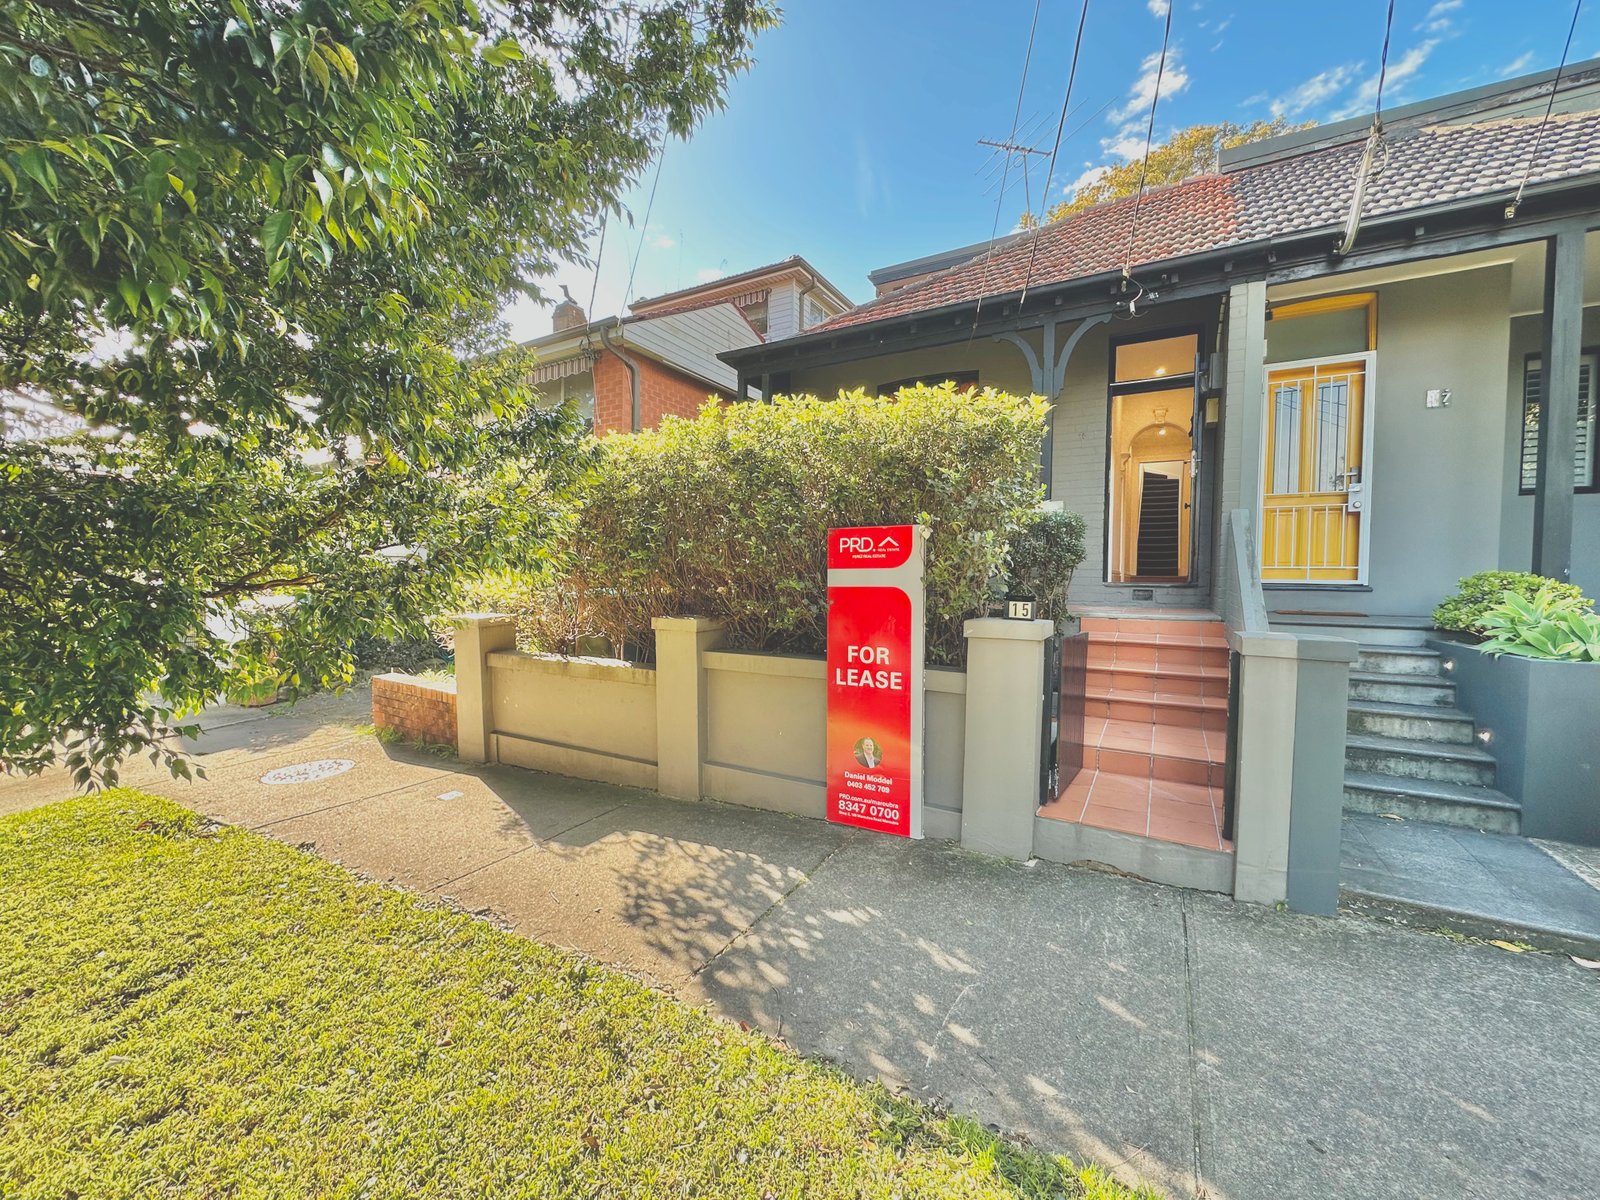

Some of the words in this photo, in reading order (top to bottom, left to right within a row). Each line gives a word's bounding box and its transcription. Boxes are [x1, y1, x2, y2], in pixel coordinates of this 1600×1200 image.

[1012, 602, 1029, 617] 15
[847, 645, 890, 665] FOR
[836, 668, 902, 690] LEASE
[844, 771, 866, 780] Daniel
[864, 783, 876, 792] 452
[838, 800, 866, 814] 8347
[869, 805, 899, 820] 0700
